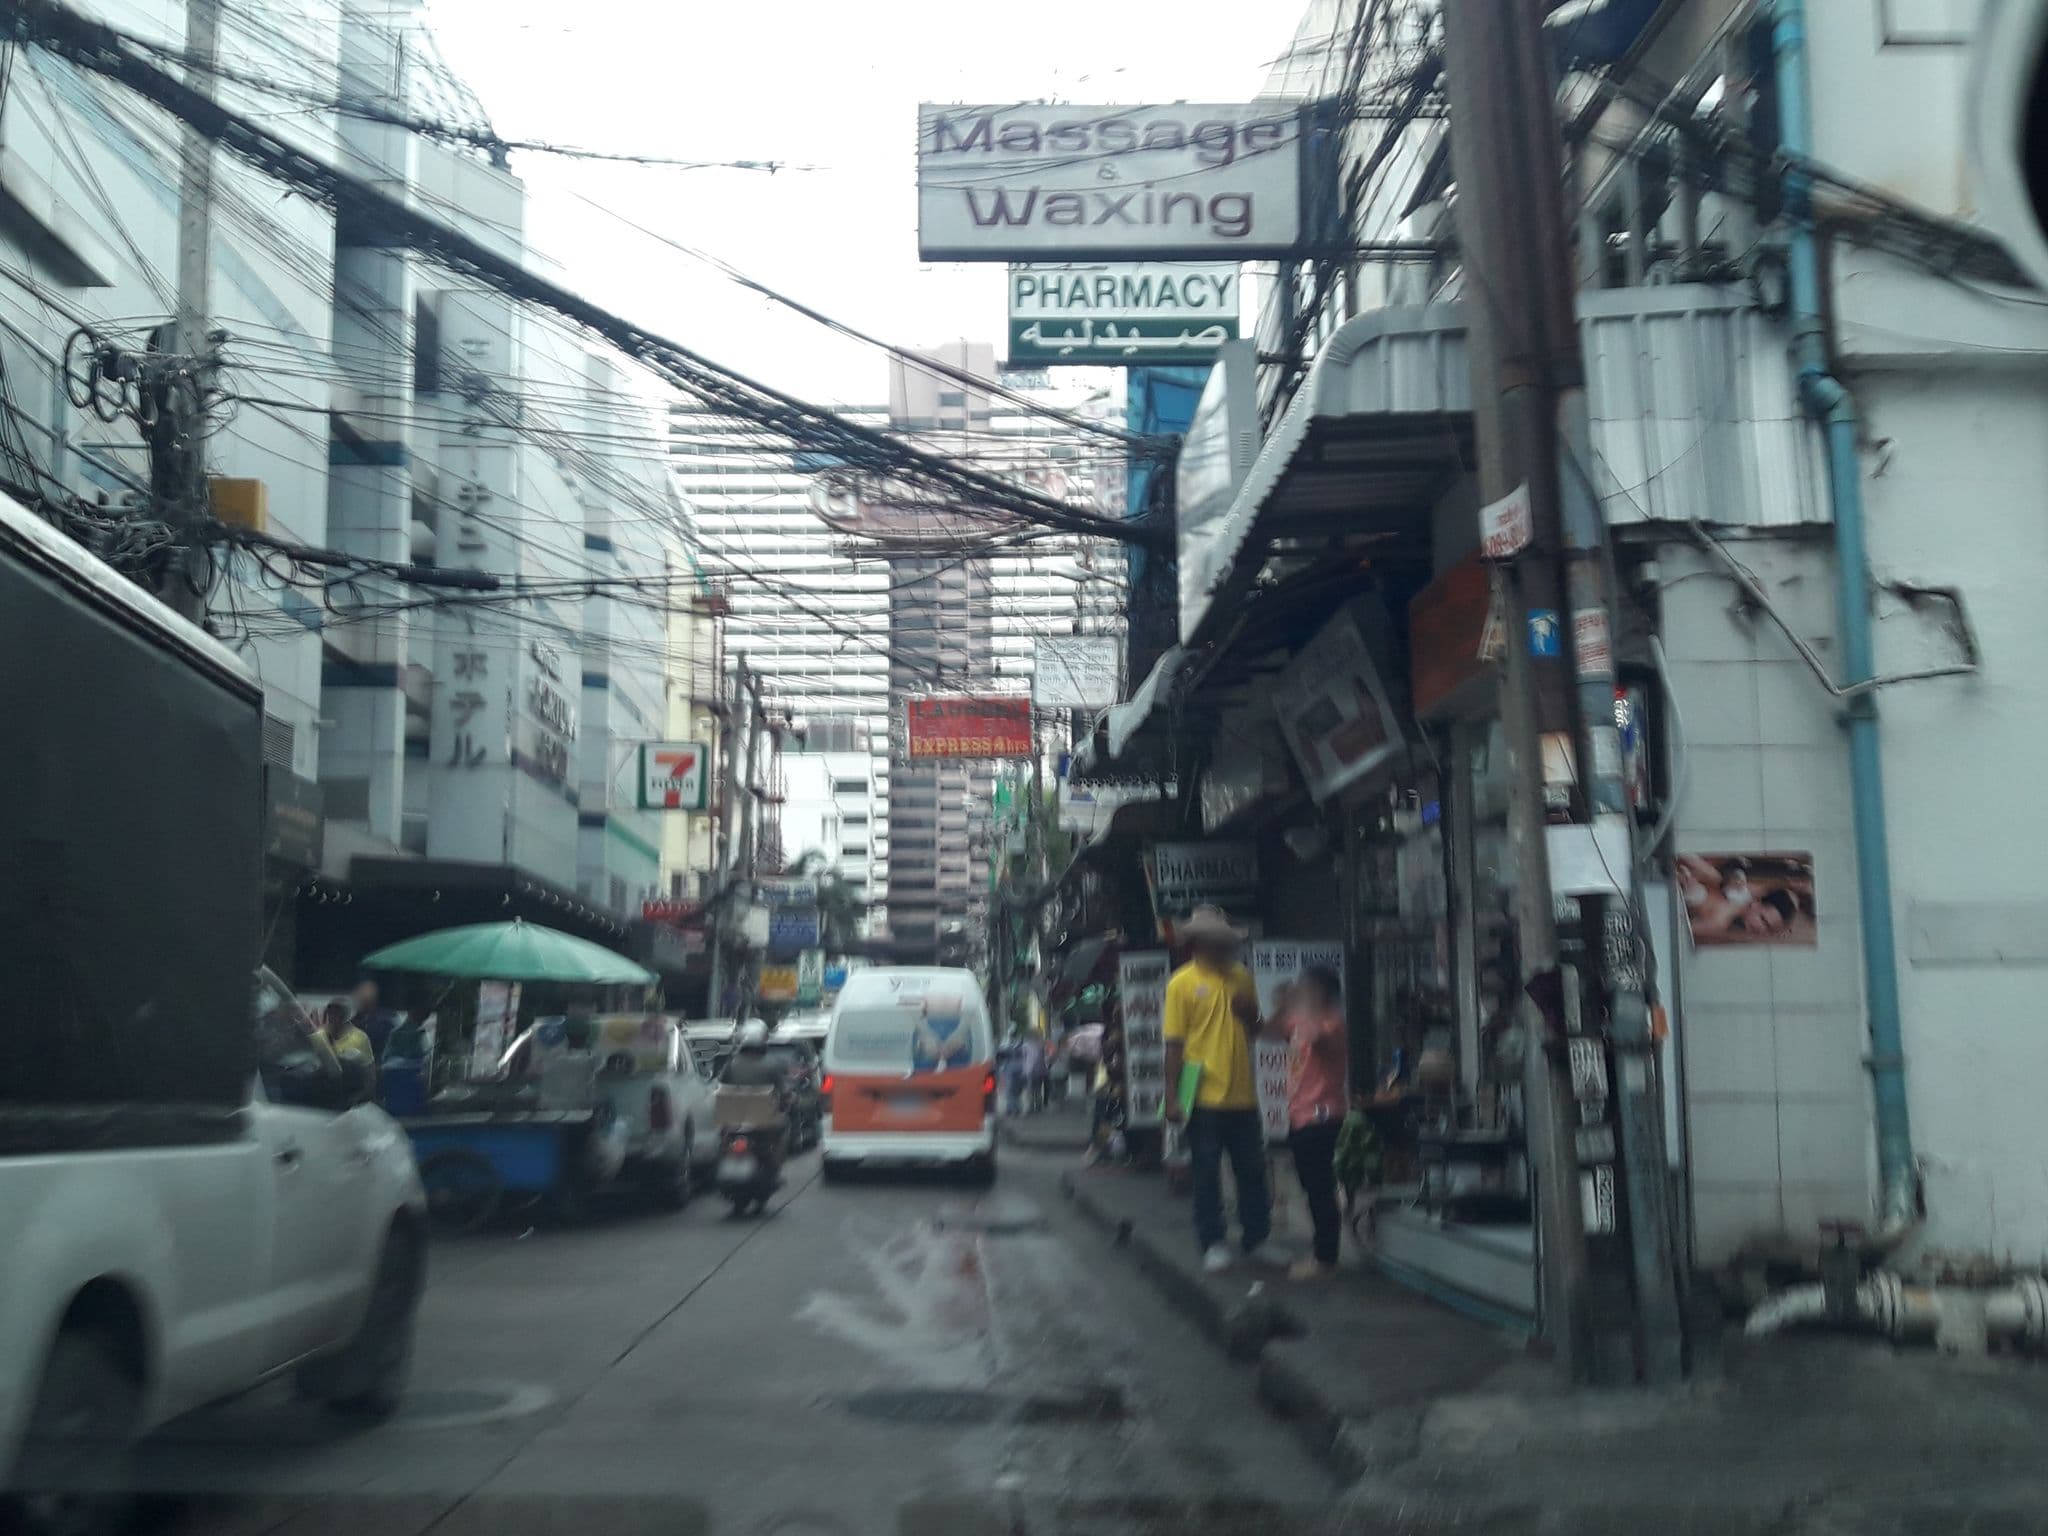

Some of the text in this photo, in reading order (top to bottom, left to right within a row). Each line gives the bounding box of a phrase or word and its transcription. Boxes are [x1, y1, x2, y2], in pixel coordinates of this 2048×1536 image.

[934, 111, 1284, 166] Massage
[1097, 160, 1120, 181] &
[965, 183, 1254, 238] Waxing
[1016, 273, 1233, 308] PHARMACY
[655, 751, 695, 808] 7
